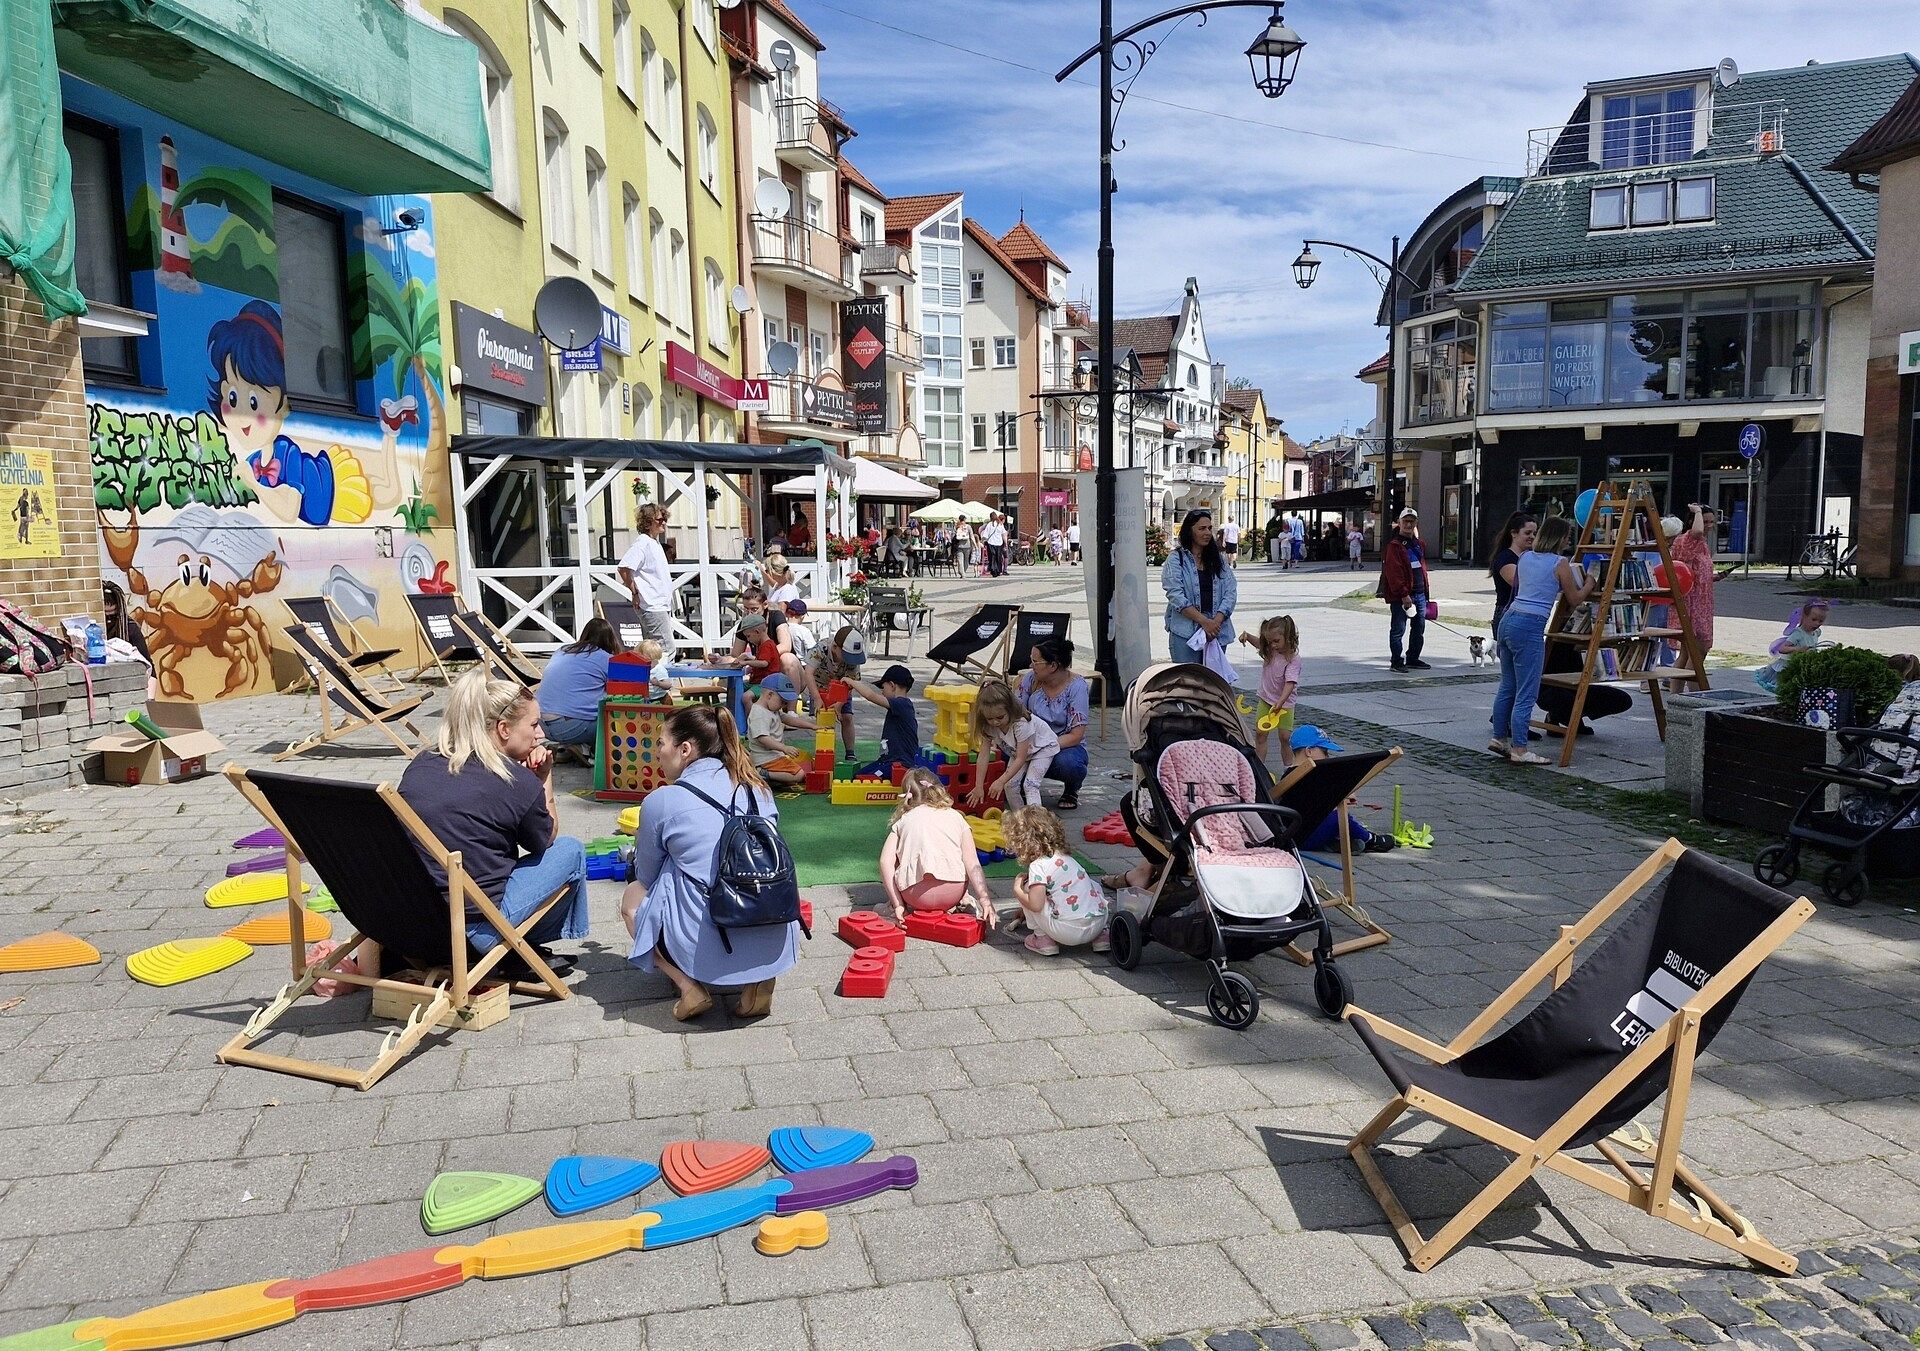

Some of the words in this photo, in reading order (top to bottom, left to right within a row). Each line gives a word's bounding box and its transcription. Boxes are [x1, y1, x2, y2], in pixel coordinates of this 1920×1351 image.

[846, 303, 883, 316] PŁYTKI
[477, 327, 534, 371] Pierogarnia
[851, 340, 878, 348] DESIGNER
[1555, 344, 1599, 359] GALERIA
[565, 350, 596, 358] SKLEP
[1514, 347, 1544, 362] WEBER
[1554, 363, 1566, 373] PO
[744, 380, 763, 399] M
[816, 390, 844, 410] PŁYTKI
[1, 468, 45, 486] CZYTELNIA
[1663, 949, 1713, 988] BIBLIOTEK
